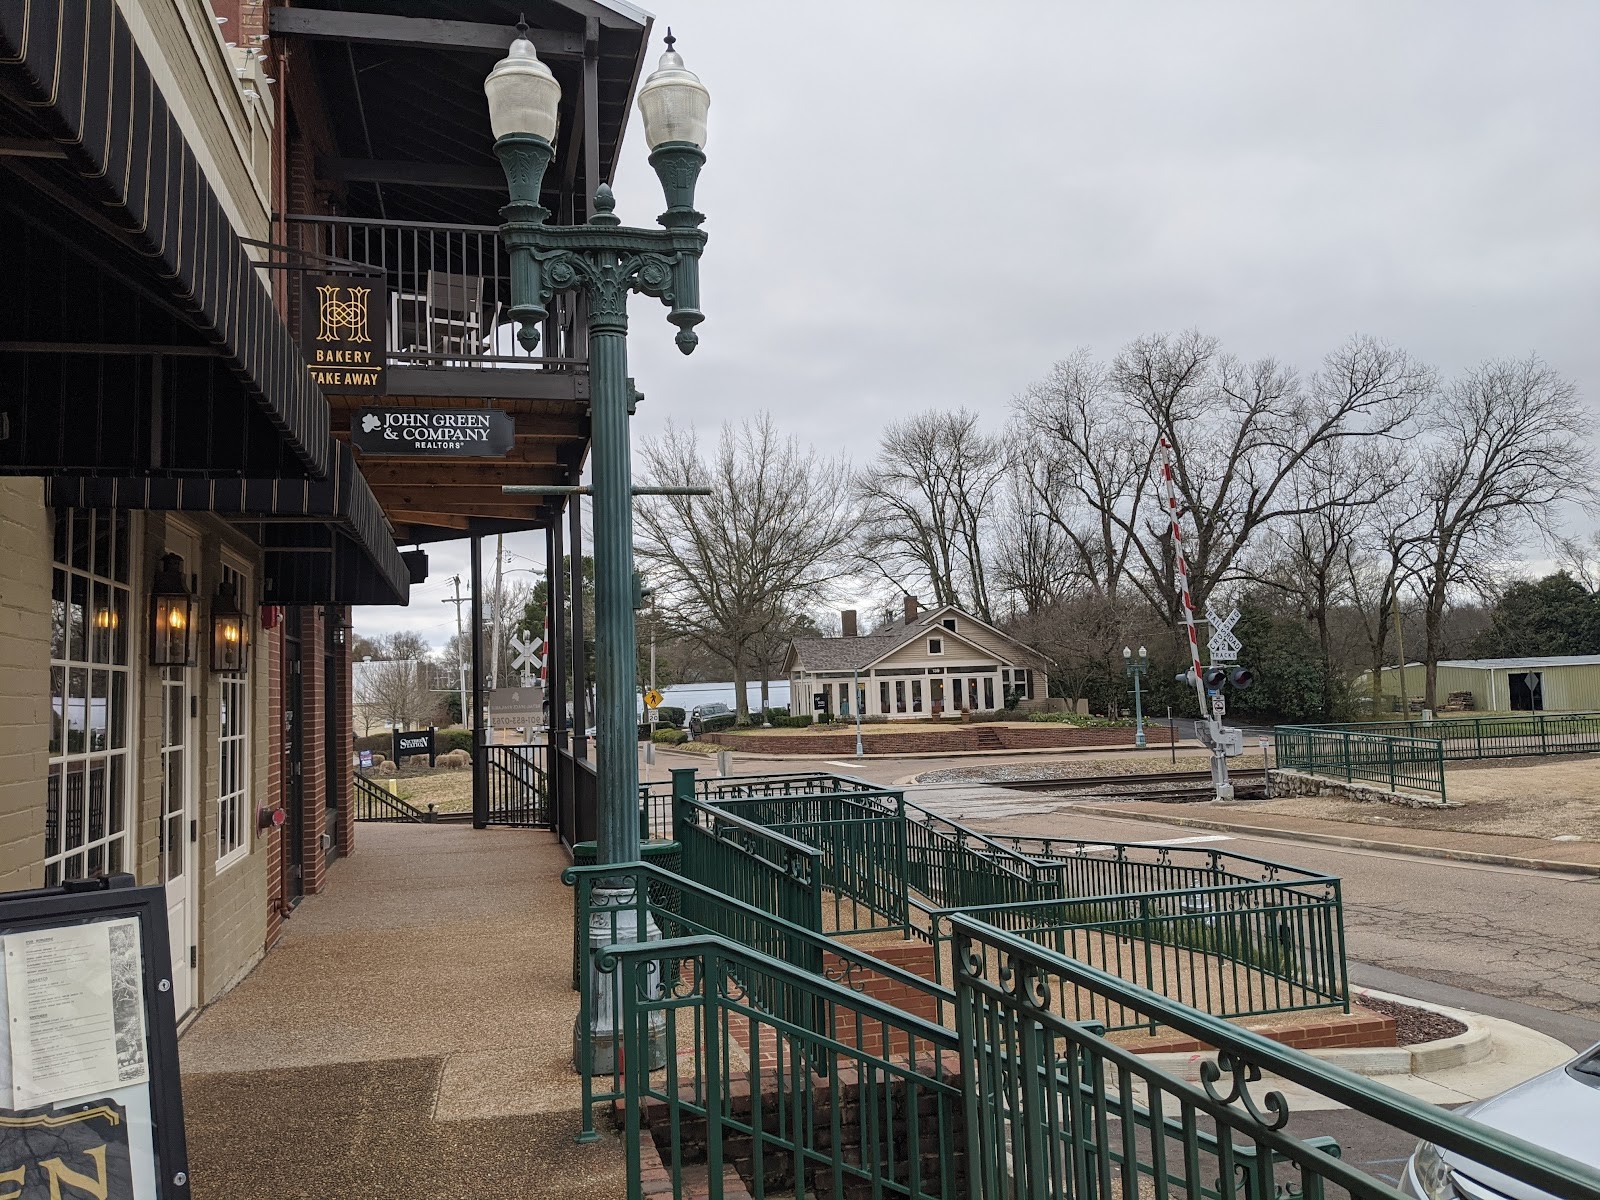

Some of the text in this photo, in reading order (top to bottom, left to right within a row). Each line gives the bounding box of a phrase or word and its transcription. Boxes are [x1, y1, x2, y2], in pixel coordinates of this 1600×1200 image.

[316, 350, 371, 363] BAKERY
[310, 372, 378, 385] TAKE AWAY
[384, 413, 490, 428] JOHN GREEN
[383, 428, 490, 441] & COMPANY
[1207, 611, 1221, 629] RAIL
[1209, 611, 1240, 650] CROSSING
[1221, 642, 1226, 650] 2
